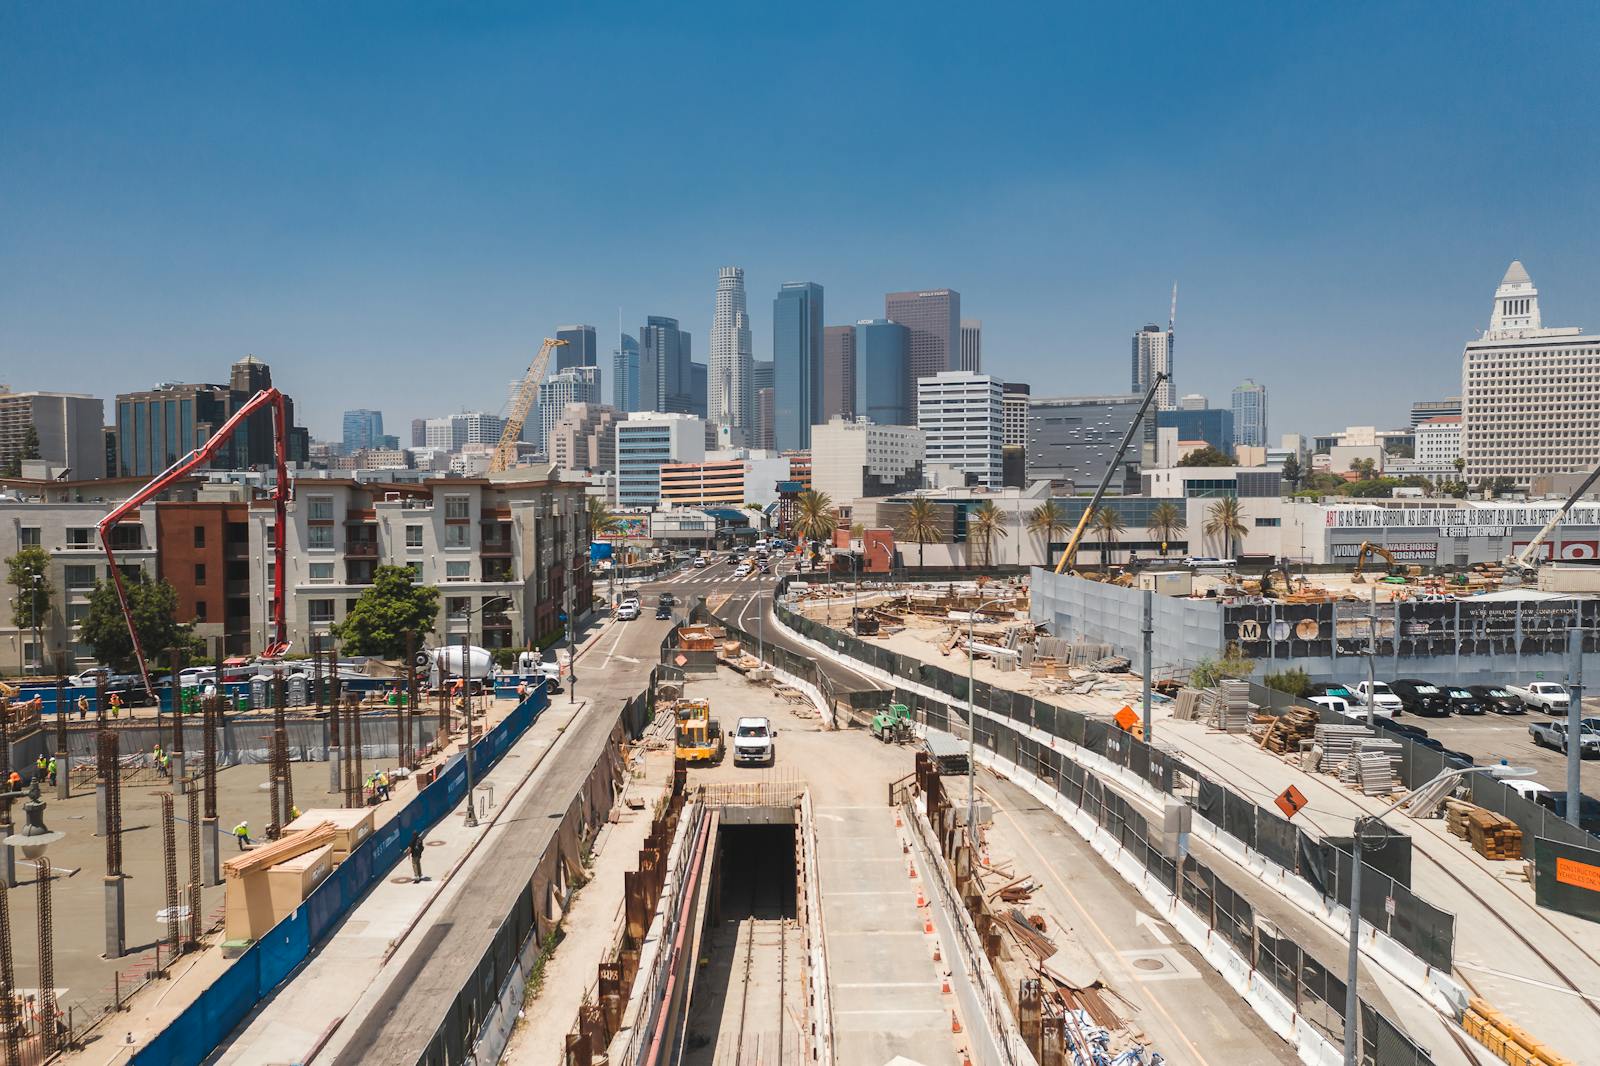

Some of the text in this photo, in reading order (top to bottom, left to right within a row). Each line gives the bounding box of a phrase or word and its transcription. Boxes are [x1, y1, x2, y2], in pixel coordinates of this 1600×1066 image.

[1326, 510, 1337, 527] ART
[1338, 510, 1345, 527] IS
[1346, 510, 1353, 527] AS
[1355, 510, 1373, 527] HEAVY
[1374, 510, 1381, 527] AS
[1408, 510, 1415, 526] AS
[1417, 510, 1431, 526] LIGHT
[1433, 510, 1440, 526] AS
[1442, 510, 1446, 526] A
[1469, 509, 1476, 526] AS
[1478, 509, 1496, 525] BRIGHT
[1498, 509, 1505, 525] AS
[1506, 509, 1514, 525] AN
[1530, 509, 1537, 525] AS
[1568, 509, 1572, 524] A
[1440, 527, 1512, 537] THE GEFFEN CONTEMPORARY AT
[1390, 551, 1436, 560] ROGRAMS
[1243, 624, 1257, 638] M
